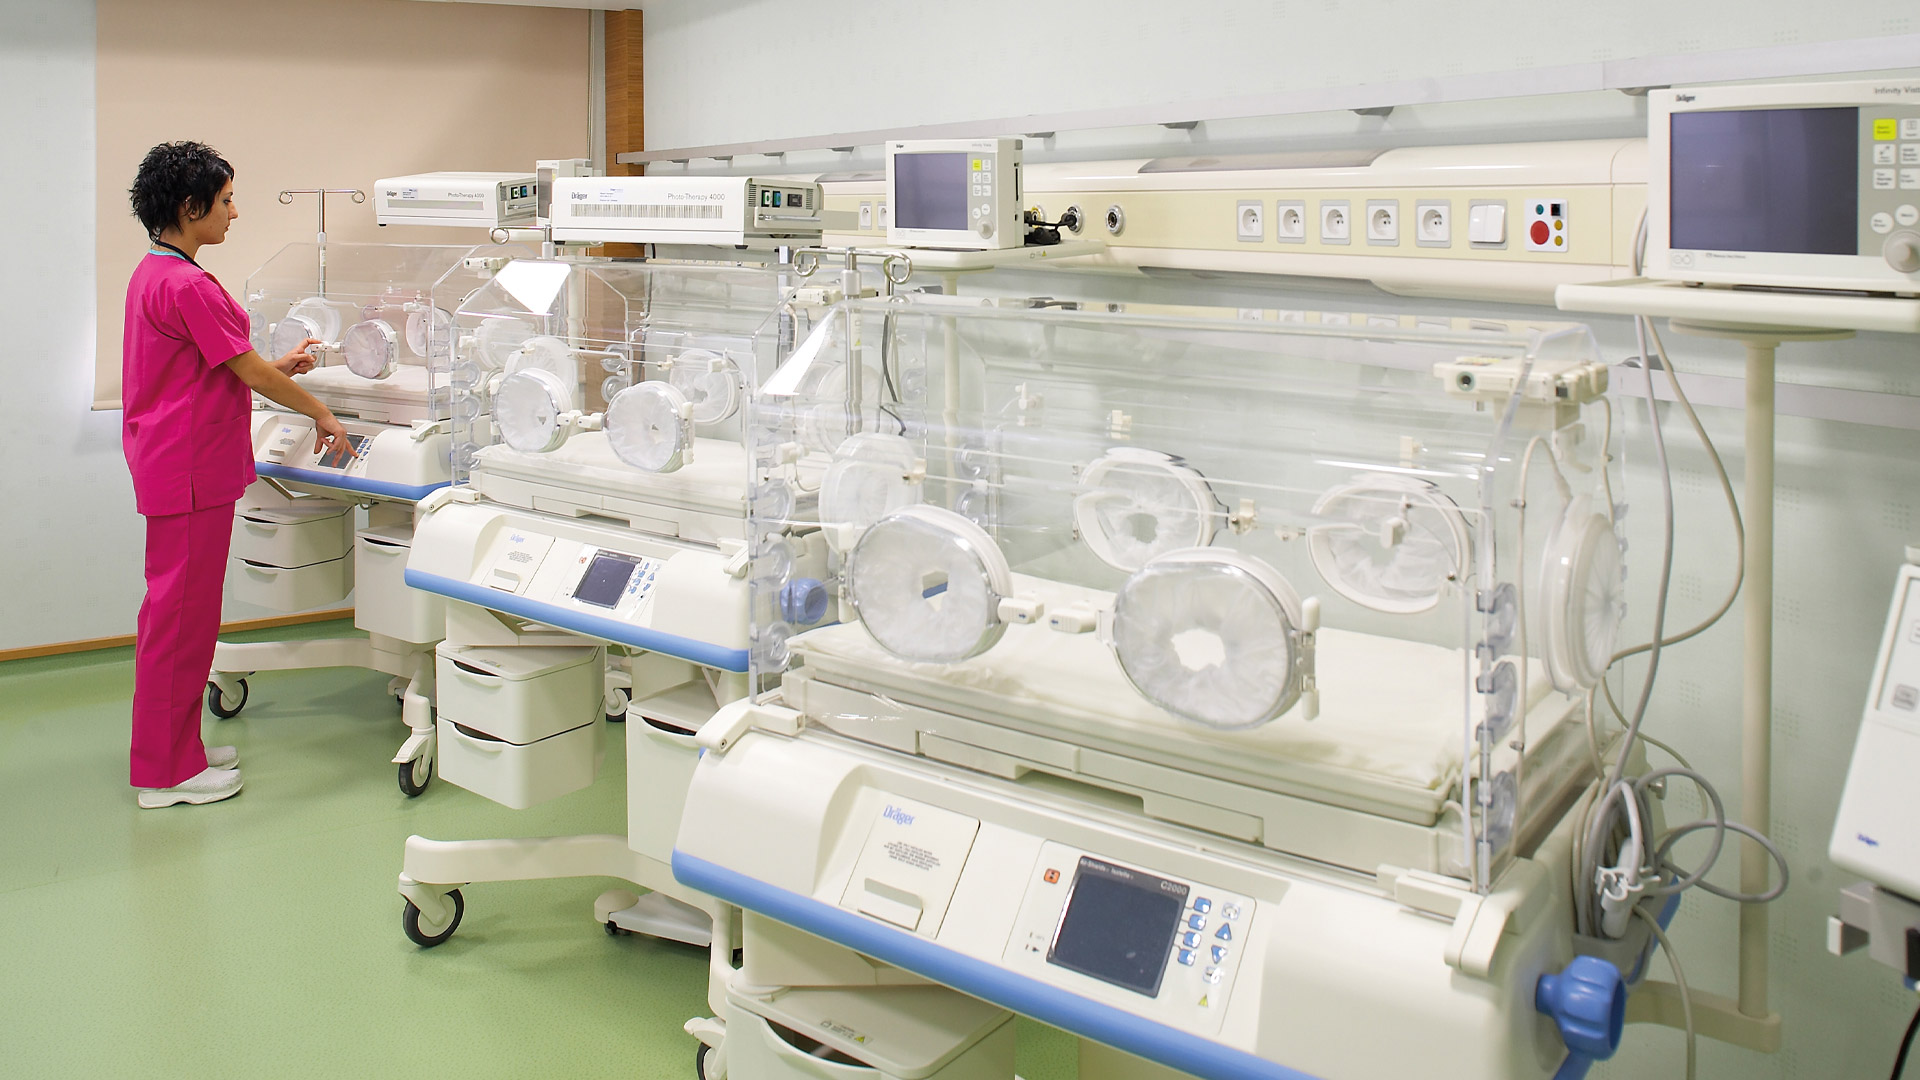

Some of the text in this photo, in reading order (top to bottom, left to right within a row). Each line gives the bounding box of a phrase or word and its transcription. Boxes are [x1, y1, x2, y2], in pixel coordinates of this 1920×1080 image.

[571, 192, 588, 201] Dräger
[883, 804, 915, 825] Dräger
[1160, 880, 1187, 896] C2000
